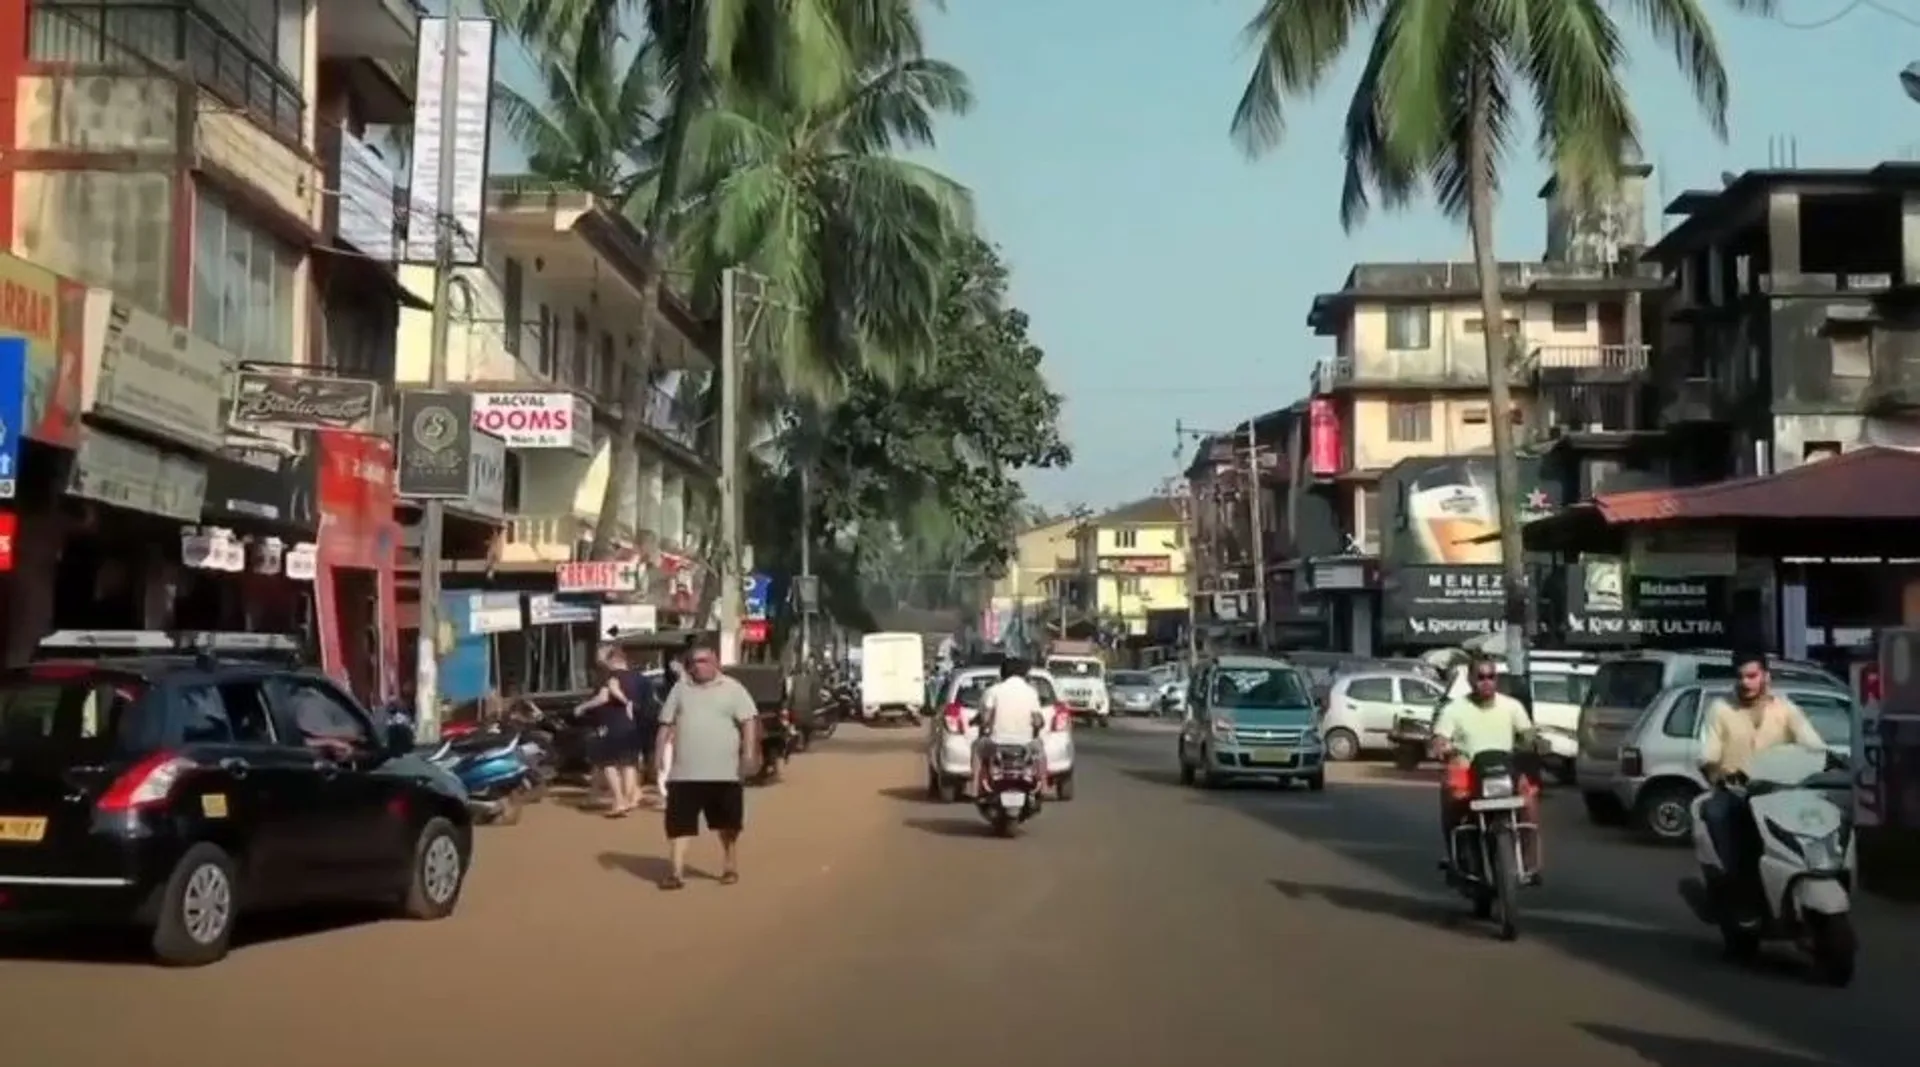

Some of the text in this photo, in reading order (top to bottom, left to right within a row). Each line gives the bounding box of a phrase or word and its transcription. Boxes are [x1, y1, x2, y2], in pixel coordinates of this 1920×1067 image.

[0, 276, 53, 337] RBAR
[489, 395, 545, 407] MACVAL
[472, 410, 567, 430] ROOMS
[558, 563, 616, 588] CHEMIST
[1664, 619, 1724, 634] ULTRA
